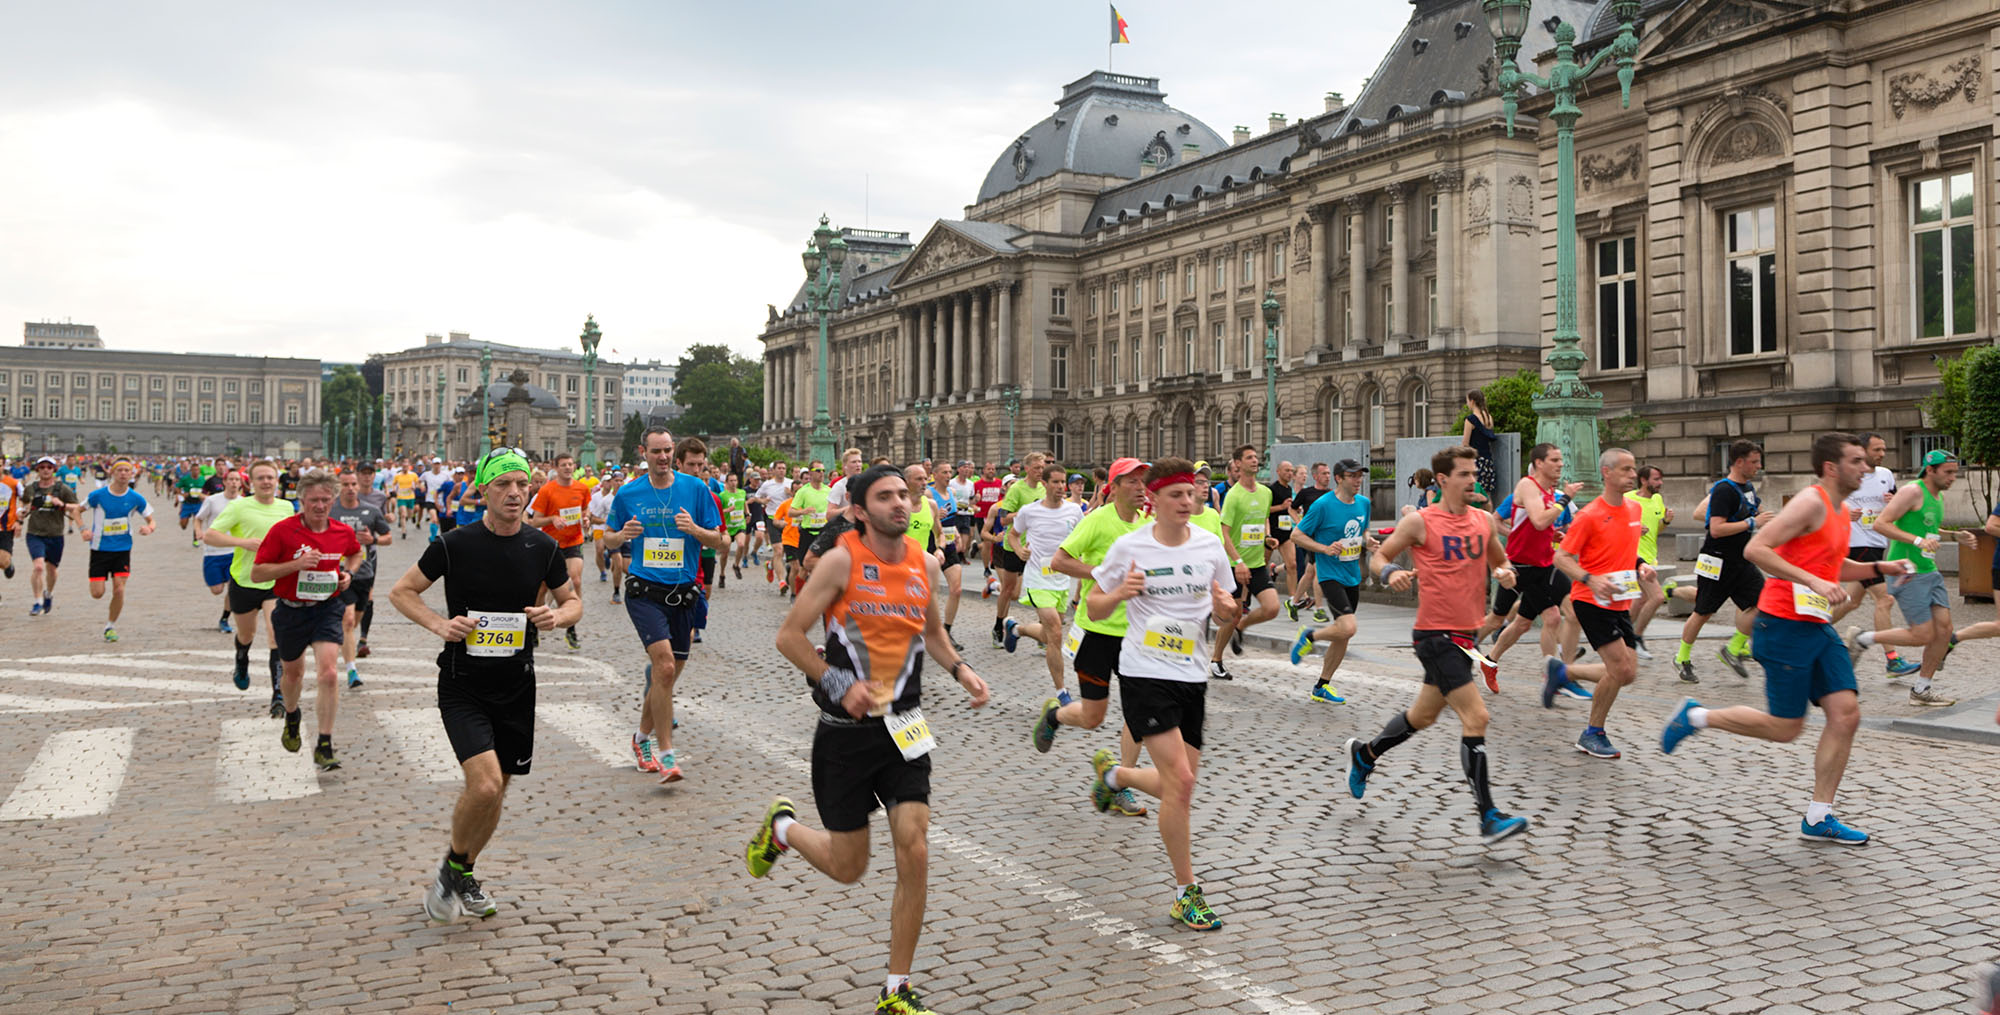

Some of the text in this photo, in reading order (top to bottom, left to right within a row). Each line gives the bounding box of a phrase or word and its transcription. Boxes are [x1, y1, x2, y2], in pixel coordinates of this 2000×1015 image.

[1442, 534, 1484, 560] RU
[652, 551, 677, 560] 1926
[475, 631, 514, 645] 3764
[1157, 635, 1184, 651] 344
